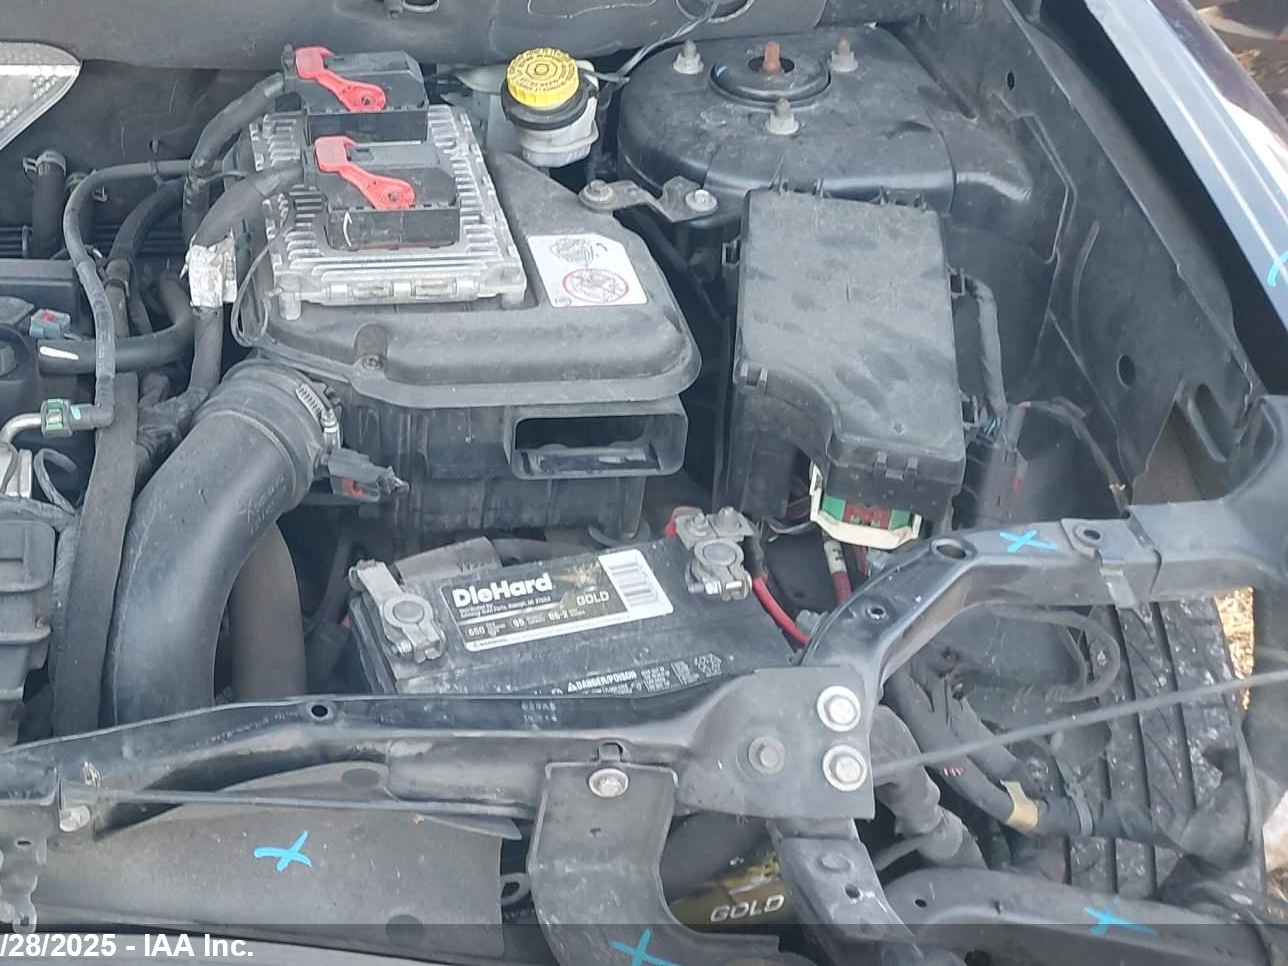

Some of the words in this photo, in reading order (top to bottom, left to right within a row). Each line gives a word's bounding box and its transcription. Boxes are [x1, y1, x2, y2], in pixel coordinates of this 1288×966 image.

[453, 572, 553, 608] DieHard
[576, 590, 610, 606] GOLD
[710, 894, 785, 922] GOLD
